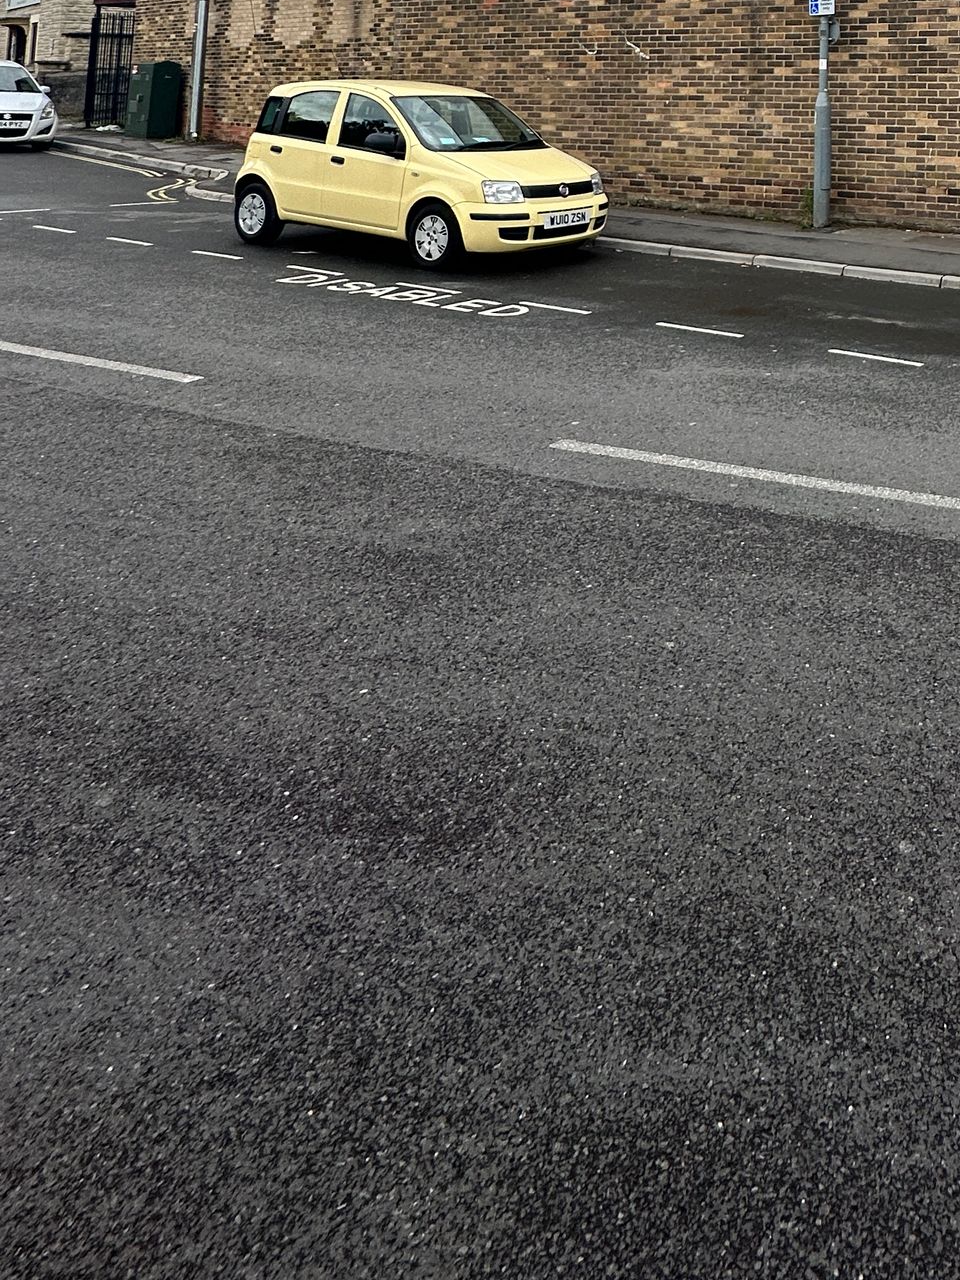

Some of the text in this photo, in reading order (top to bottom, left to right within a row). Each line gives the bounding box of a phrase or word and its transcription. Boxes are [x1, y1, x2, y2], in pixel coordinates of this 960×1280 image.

[550, 211, 586, 226] WU10 ZSN
[275, 273, 530, 317] DISABLED
